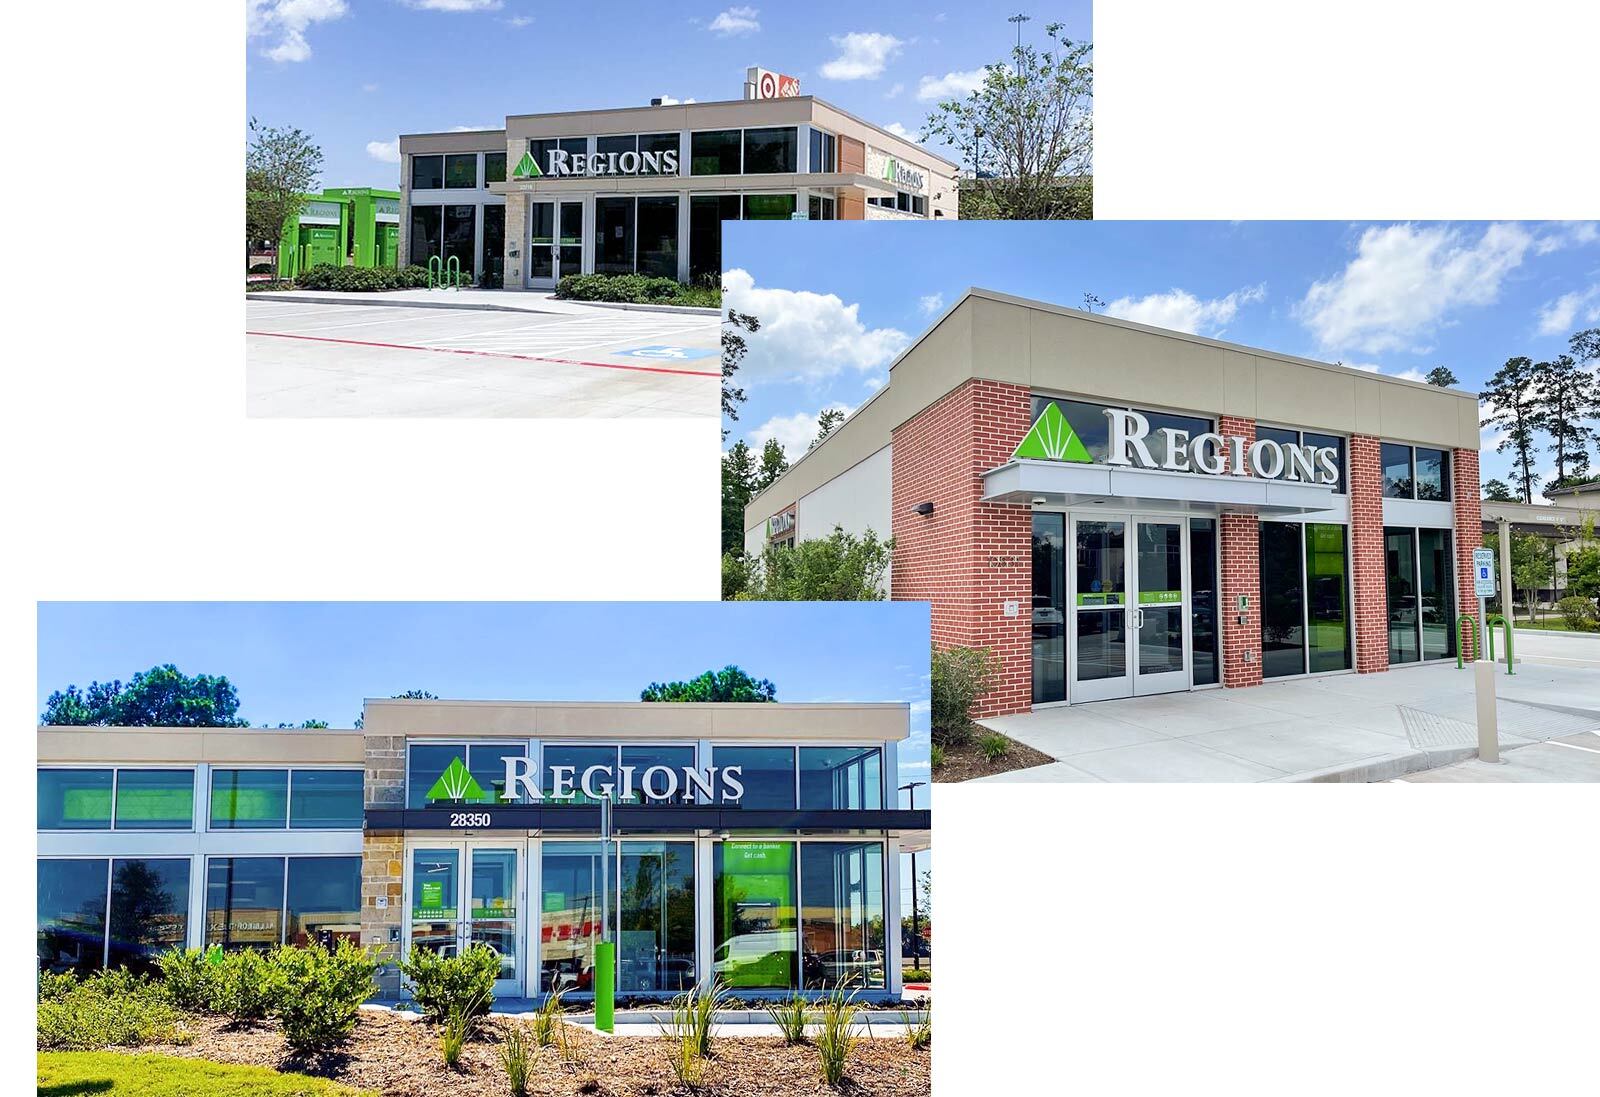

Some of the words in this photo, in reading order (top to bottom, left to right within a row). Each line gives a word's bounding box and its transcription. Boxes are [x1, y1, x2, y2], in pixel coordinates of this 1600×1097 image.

[547, 149, 679, 175] REGIONS
[1102, 407, 1340, 485] REGIONS
[500, 756, 745, 800] REGIONS
[450, 813, 491, 827] 28350
